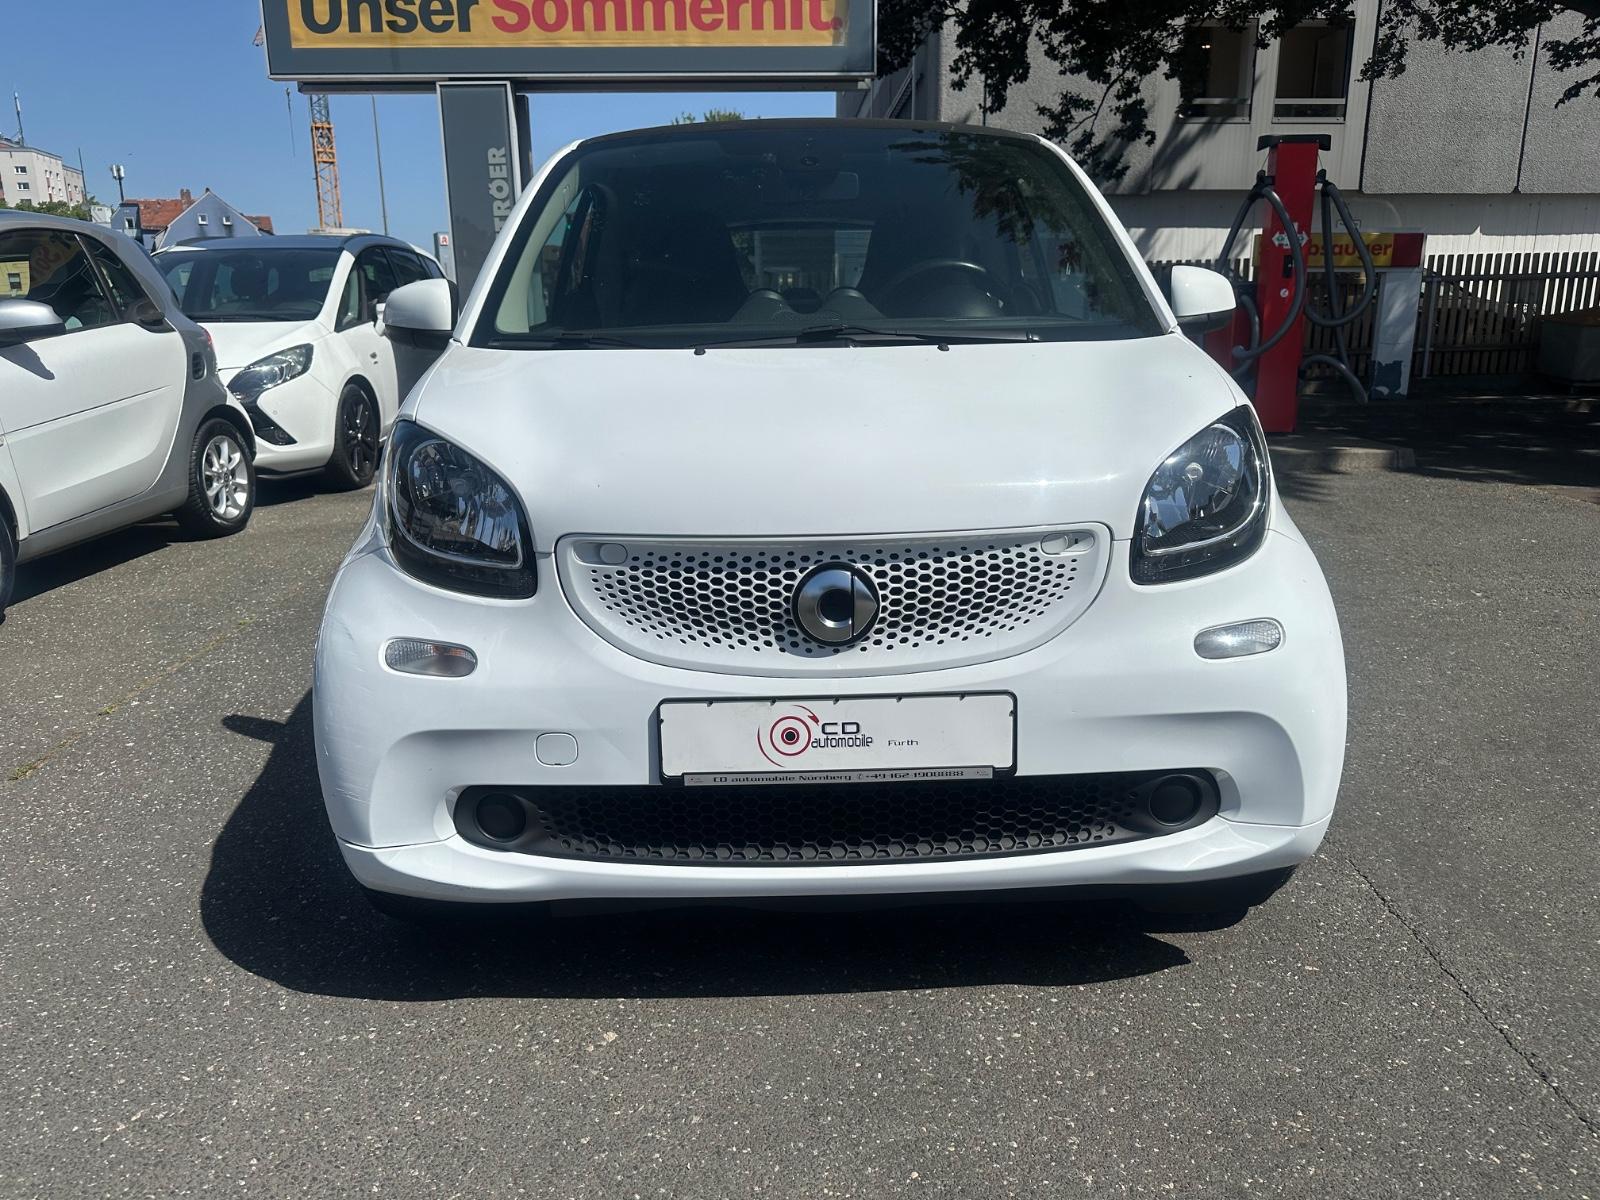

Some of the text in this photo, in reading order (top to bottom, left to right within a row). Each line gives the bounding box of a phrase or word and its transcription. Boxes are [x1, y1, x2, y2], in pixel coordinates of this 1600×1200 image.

[300, 0, 479, 34] Unser
[487, 146, 511, 233] TRÖER
[821, 721, 861, 735] CD
[811, 734, 873, 748] automobile
[731, 775, 795, 783] automobile
